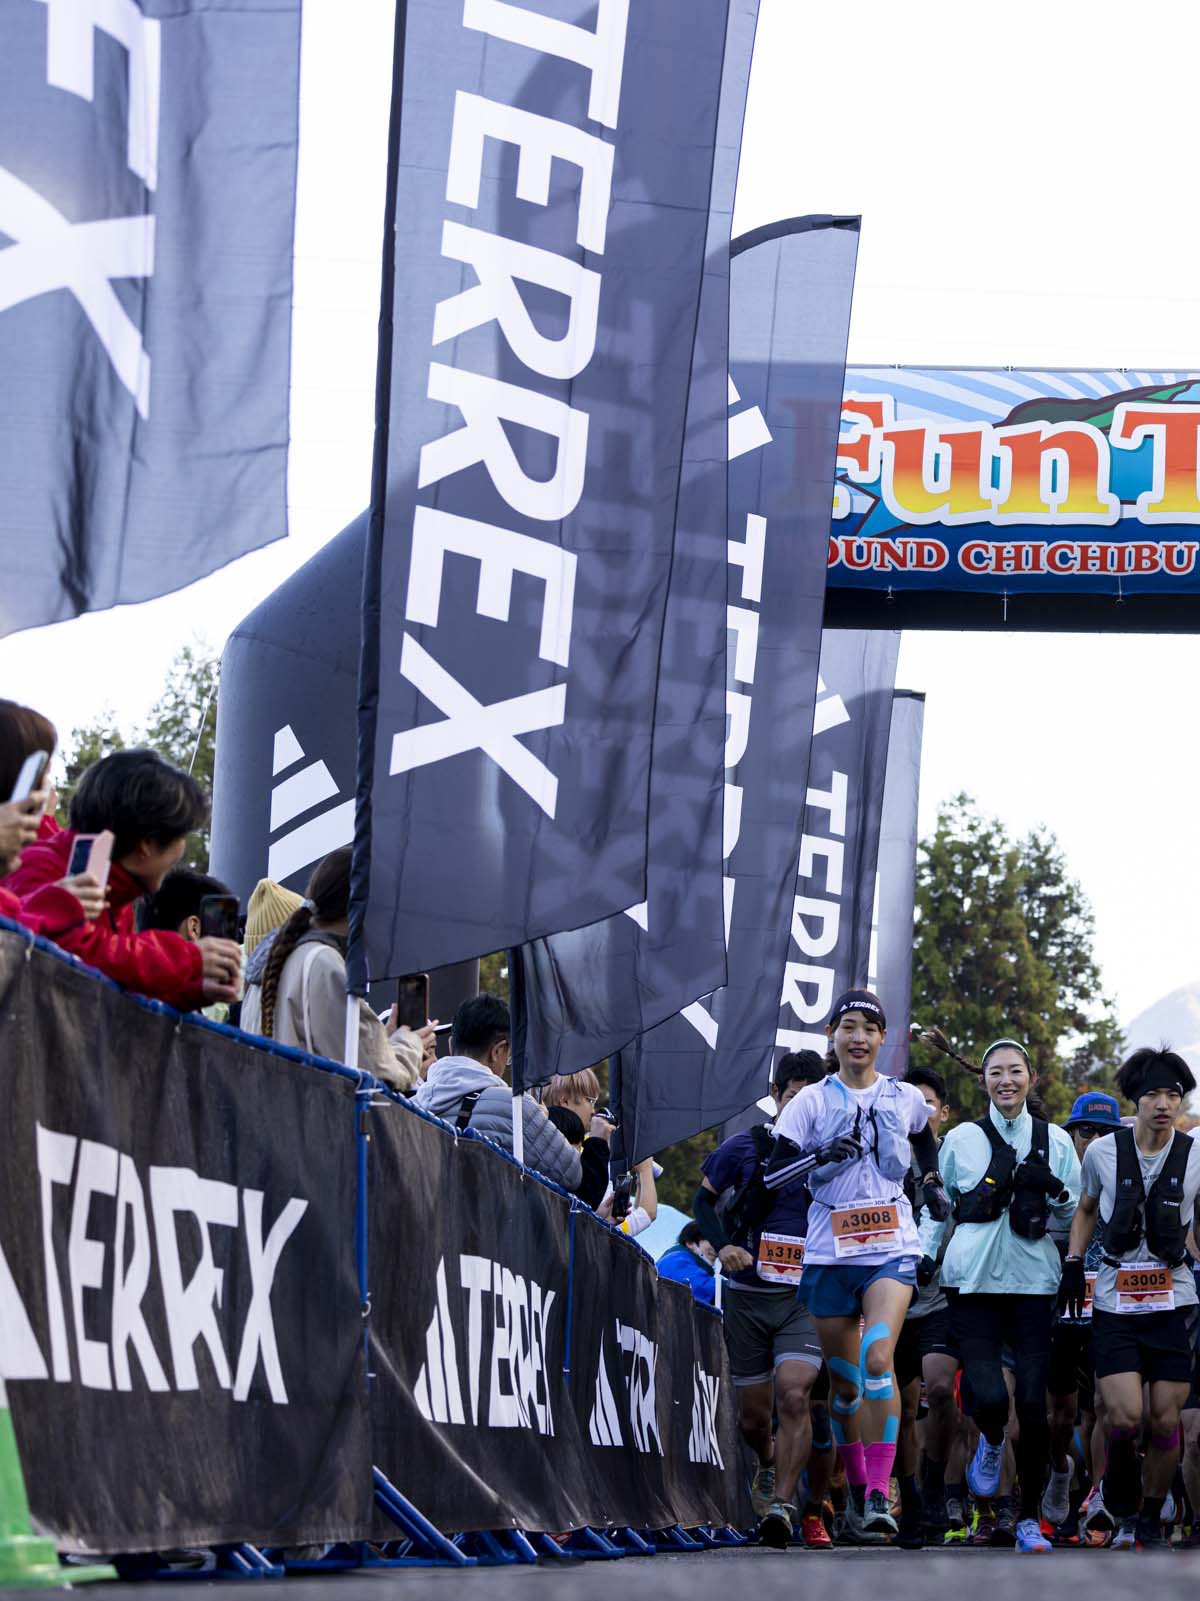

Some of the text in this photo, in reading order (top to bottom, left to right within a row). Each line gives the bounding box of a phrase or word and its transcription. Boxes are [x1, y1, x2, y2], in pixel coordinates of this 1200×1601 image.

[389, 0, 629, 820] TERREX
[960, 543, 1198, 574] CHICHIBU
[849, 1001, 880, 1013] TERREX
[842, 1211, 892, 1229] A3008
[36, 1120, 309, 1404] TERREX
[767, 1246, 805, 1260] A318
[1123, 1273, 1167, 1287] A3005
